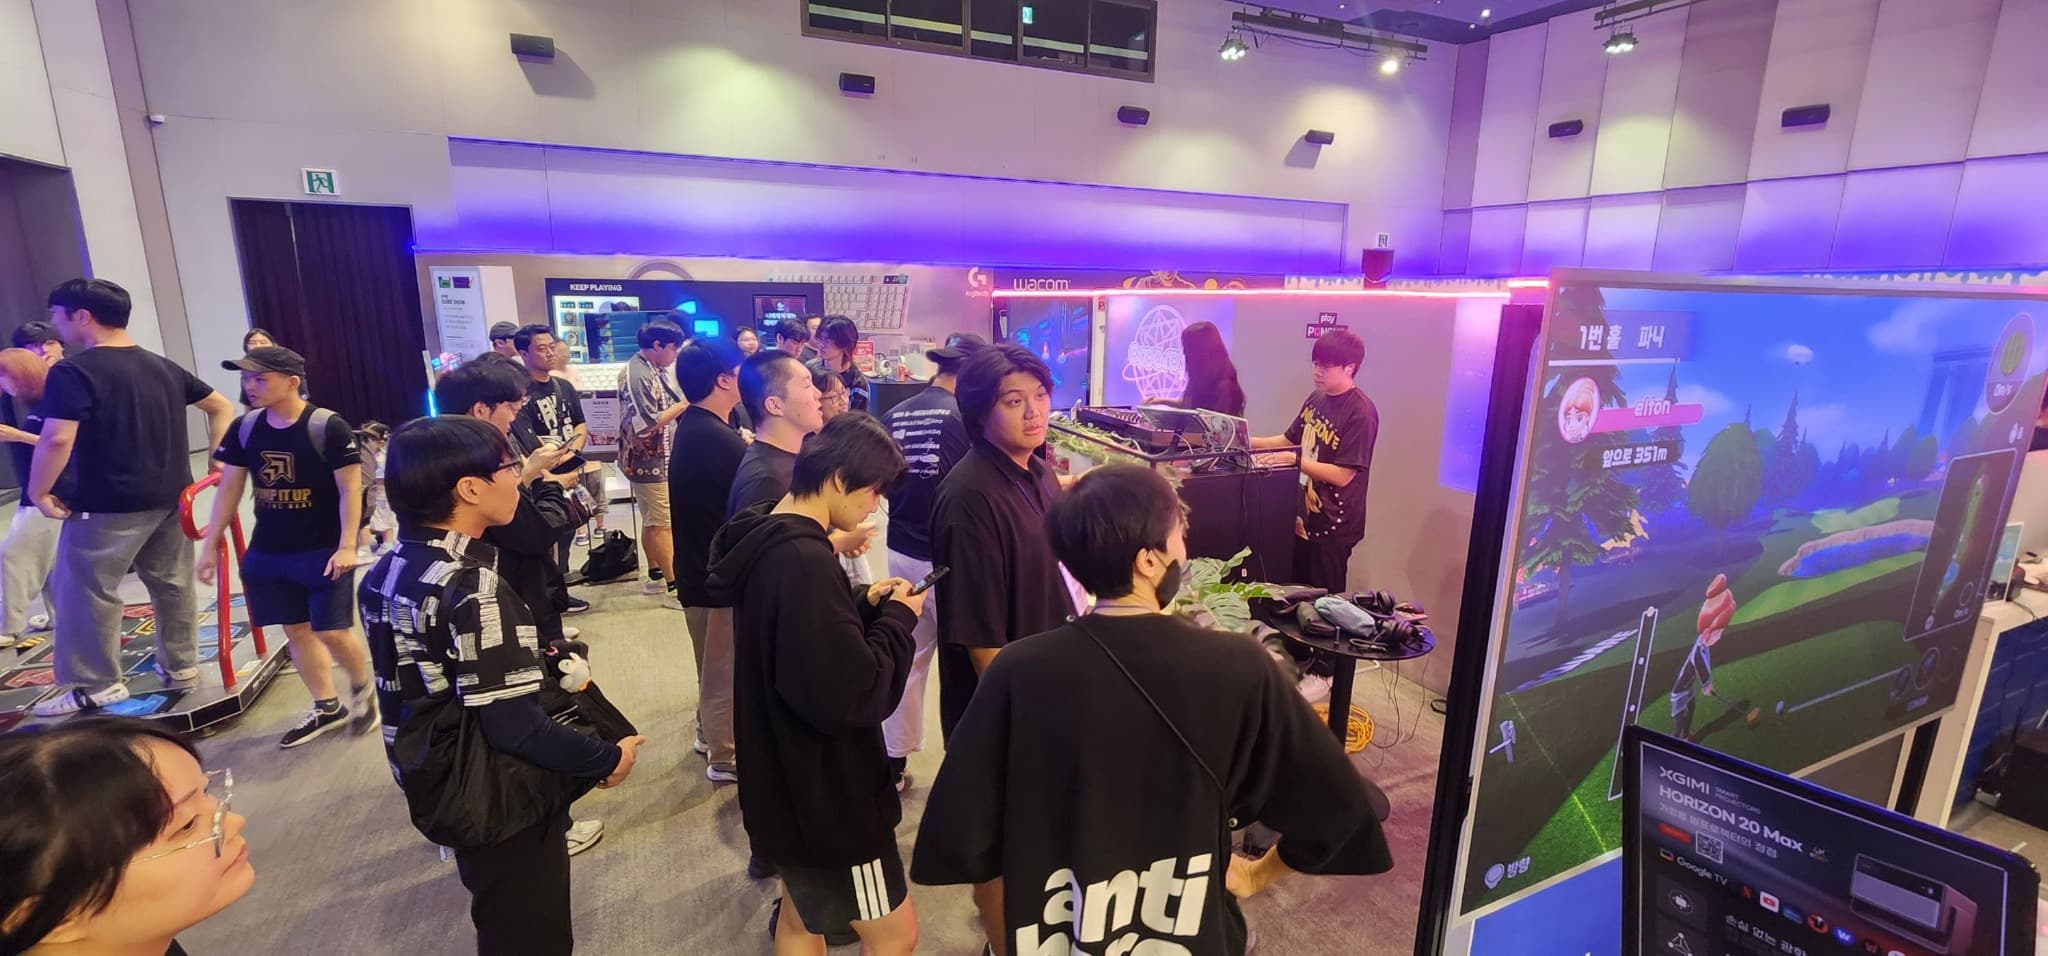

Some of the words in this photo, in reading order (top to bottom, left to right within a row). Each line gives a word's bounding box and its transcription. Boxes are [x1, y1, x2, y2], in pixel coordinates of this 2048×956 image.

[570, 283, 589, 291] KEEP
[590, 283, 623, 292] PLAYING
[1013, 278, 1069, 291] wacom
[1320, 313, 1336, 324] play
[1607, 324, 1622, 351] 홀
[1602, 447, 1632, 468] 앞으로
[1634, 445, 1668, 464] 351m
[292, 488, 311, 501] UP
[1659, 766, 1709, 795] XGIMI
[1660, 785, 1735, 826] HORIZON
[1738, 816, 1760, 835] 20
[1763, 826, 1803, 853] Max
[1677, 855, 1712, 881] Google
[1714, 874, 1728, 886] TV
[1043, 853, 1212, 943] anti
